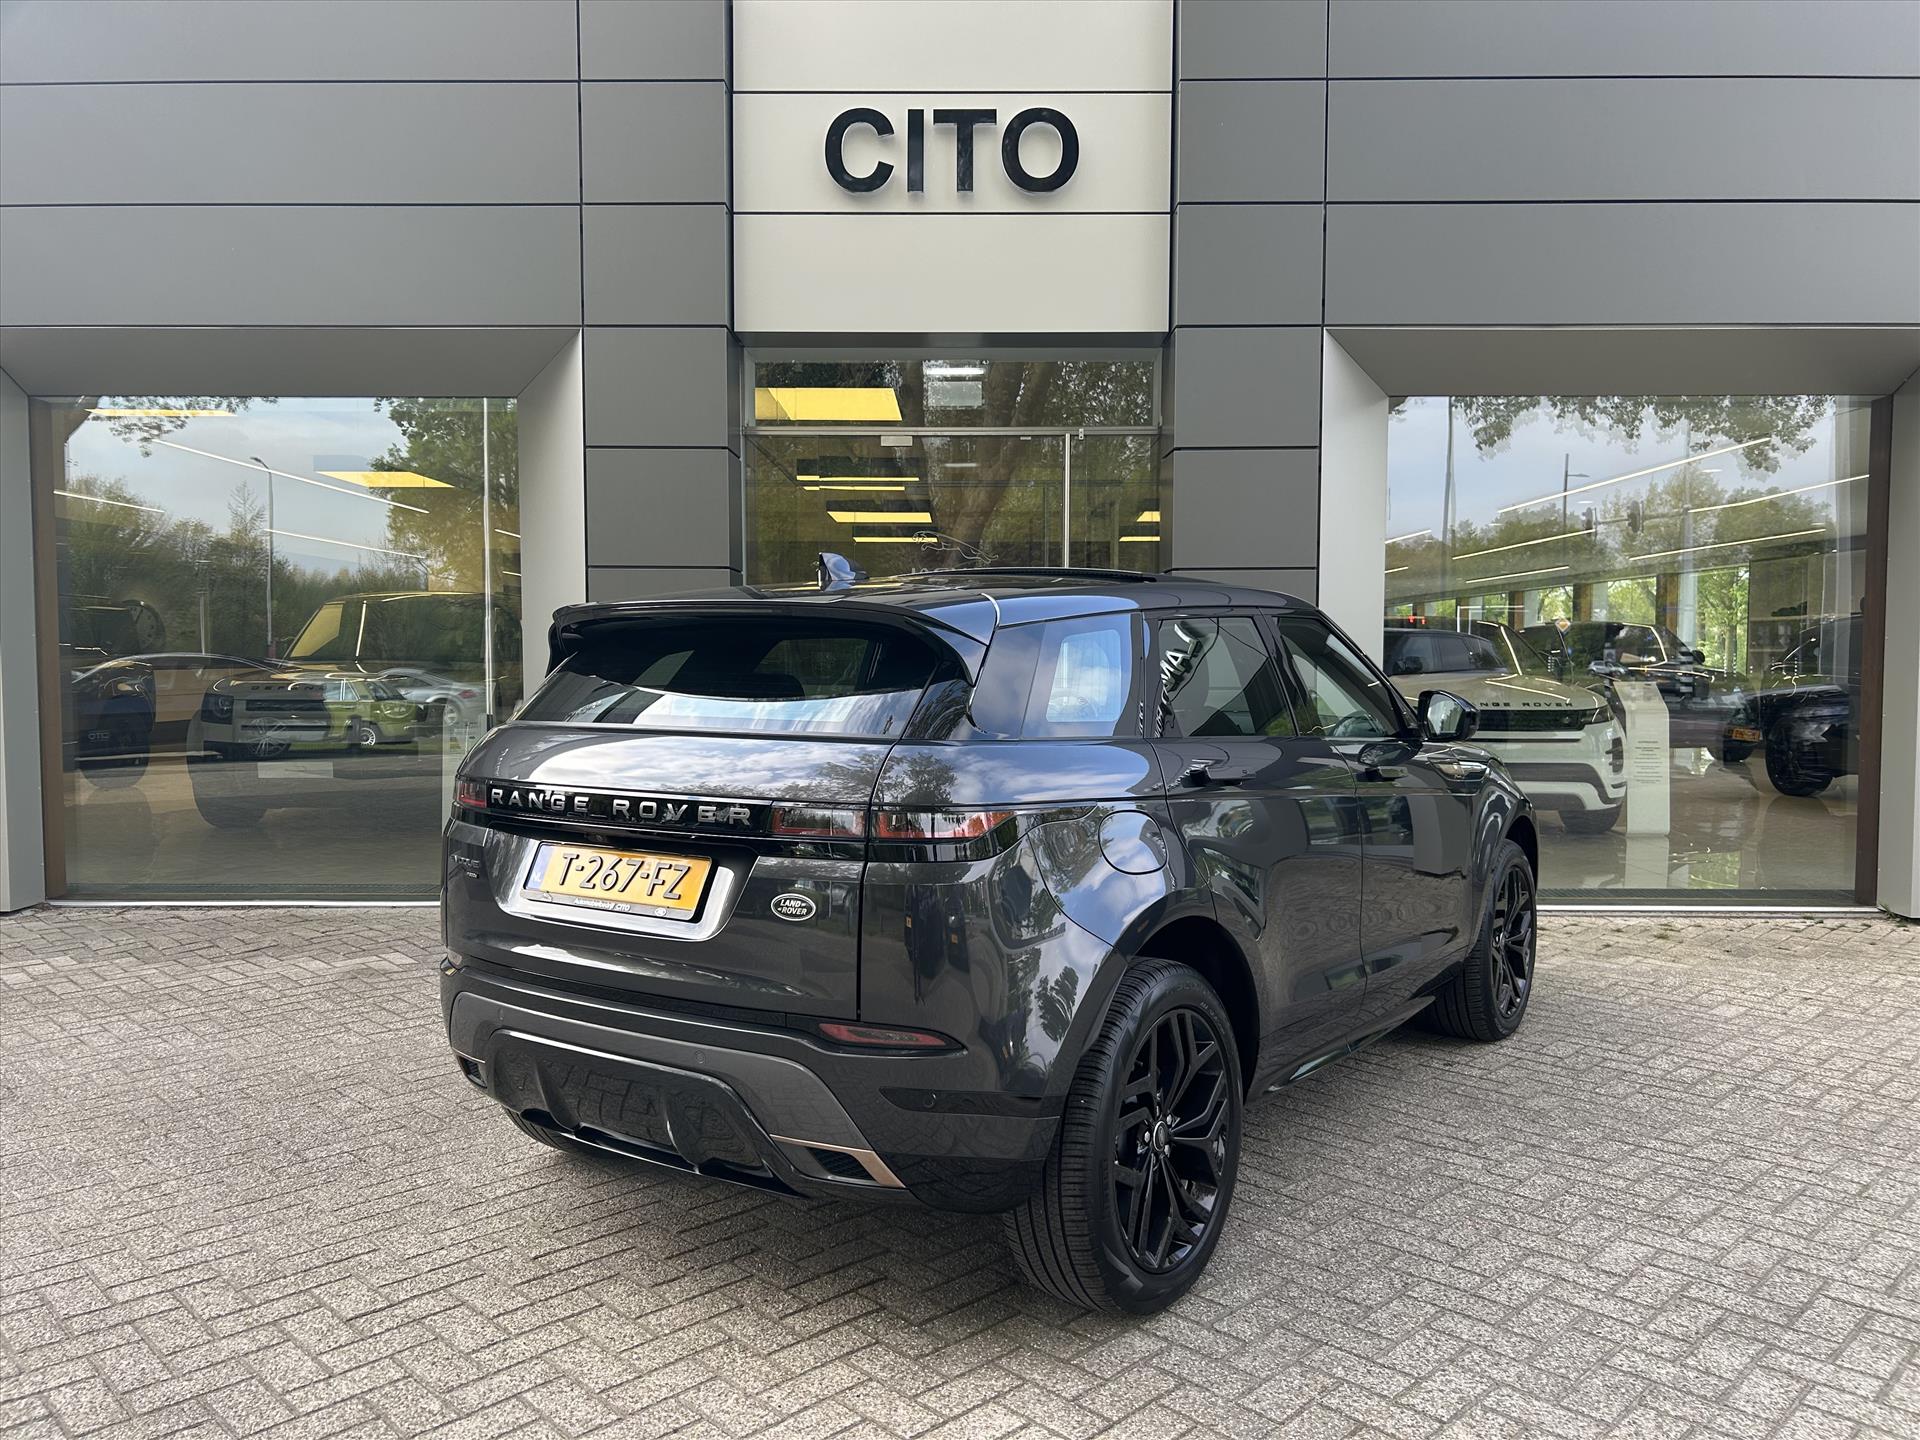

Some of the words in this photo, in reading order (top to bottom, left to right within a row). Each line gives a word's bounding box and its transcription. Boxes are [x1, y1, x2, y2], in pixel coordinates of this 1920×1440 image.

[825, 107, 1080, 193] CITO
[490, 788, 590, 812] RANGE
[612, 799, 752, 826] ROVER
[558, 852, 691, 901] T-267-FZ
[780, 900, 801, 908] LAND
[781, 906, 808, 915] ROVER
